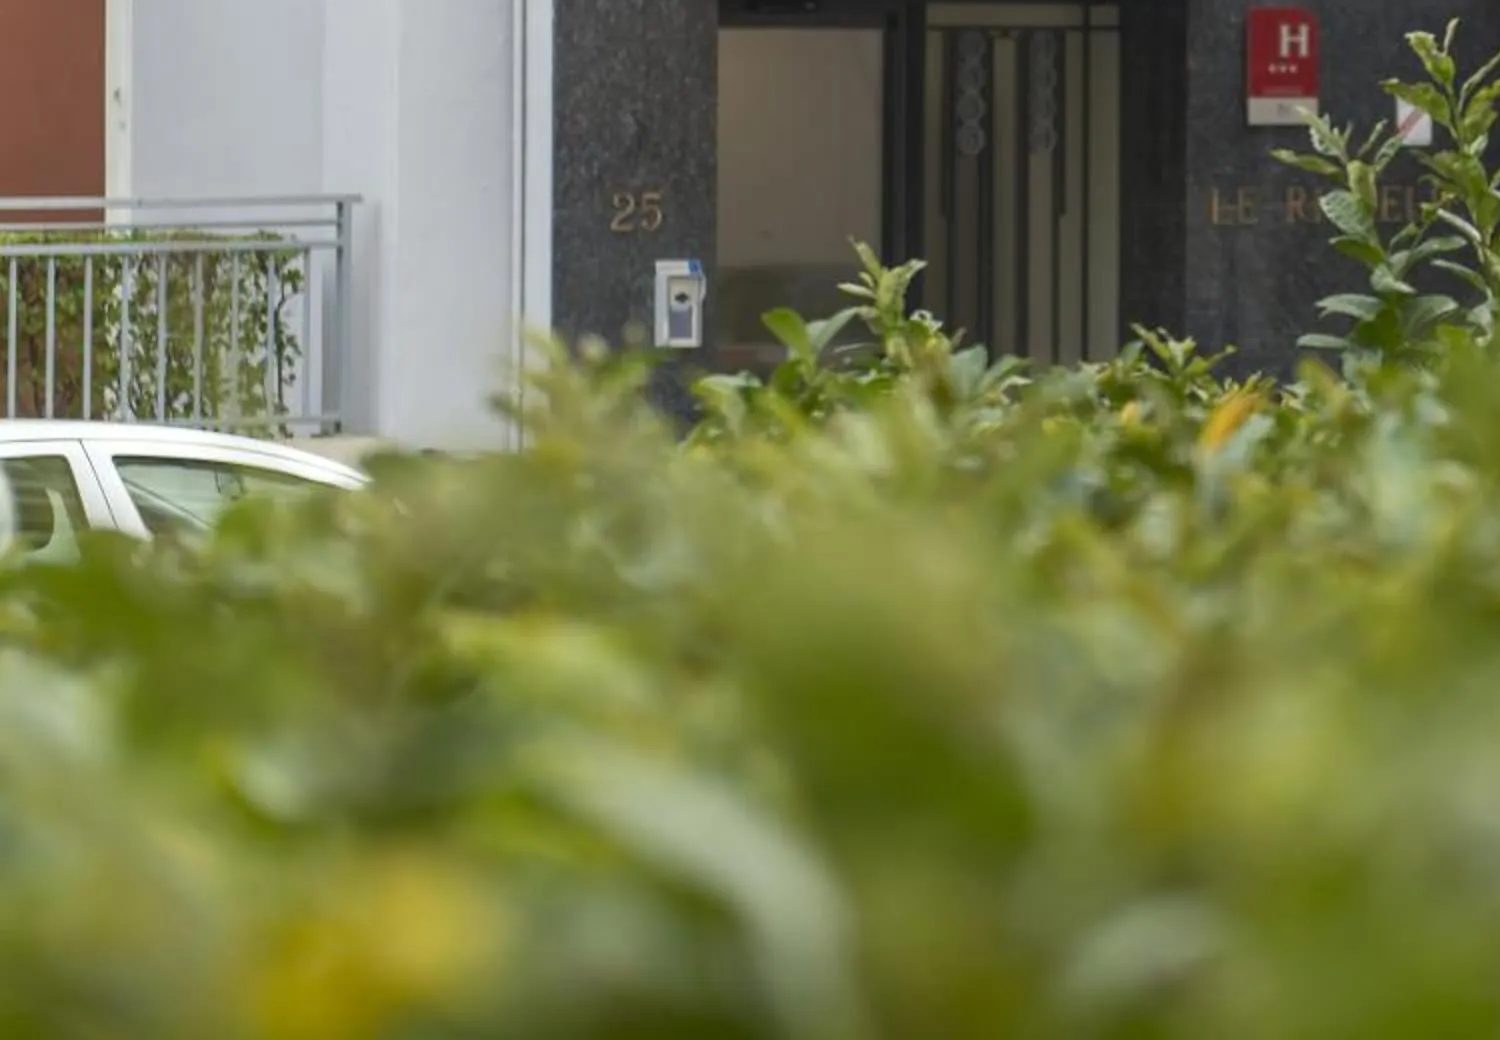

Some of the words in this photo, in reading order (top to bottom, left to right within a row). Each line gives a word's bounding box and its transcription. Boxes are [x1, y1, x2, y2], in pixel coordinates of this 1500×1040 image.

[1279, 23, 1310, 58] H
[609, 189, 664, 233] 25
[1209, 185, 1260, 226] LE
